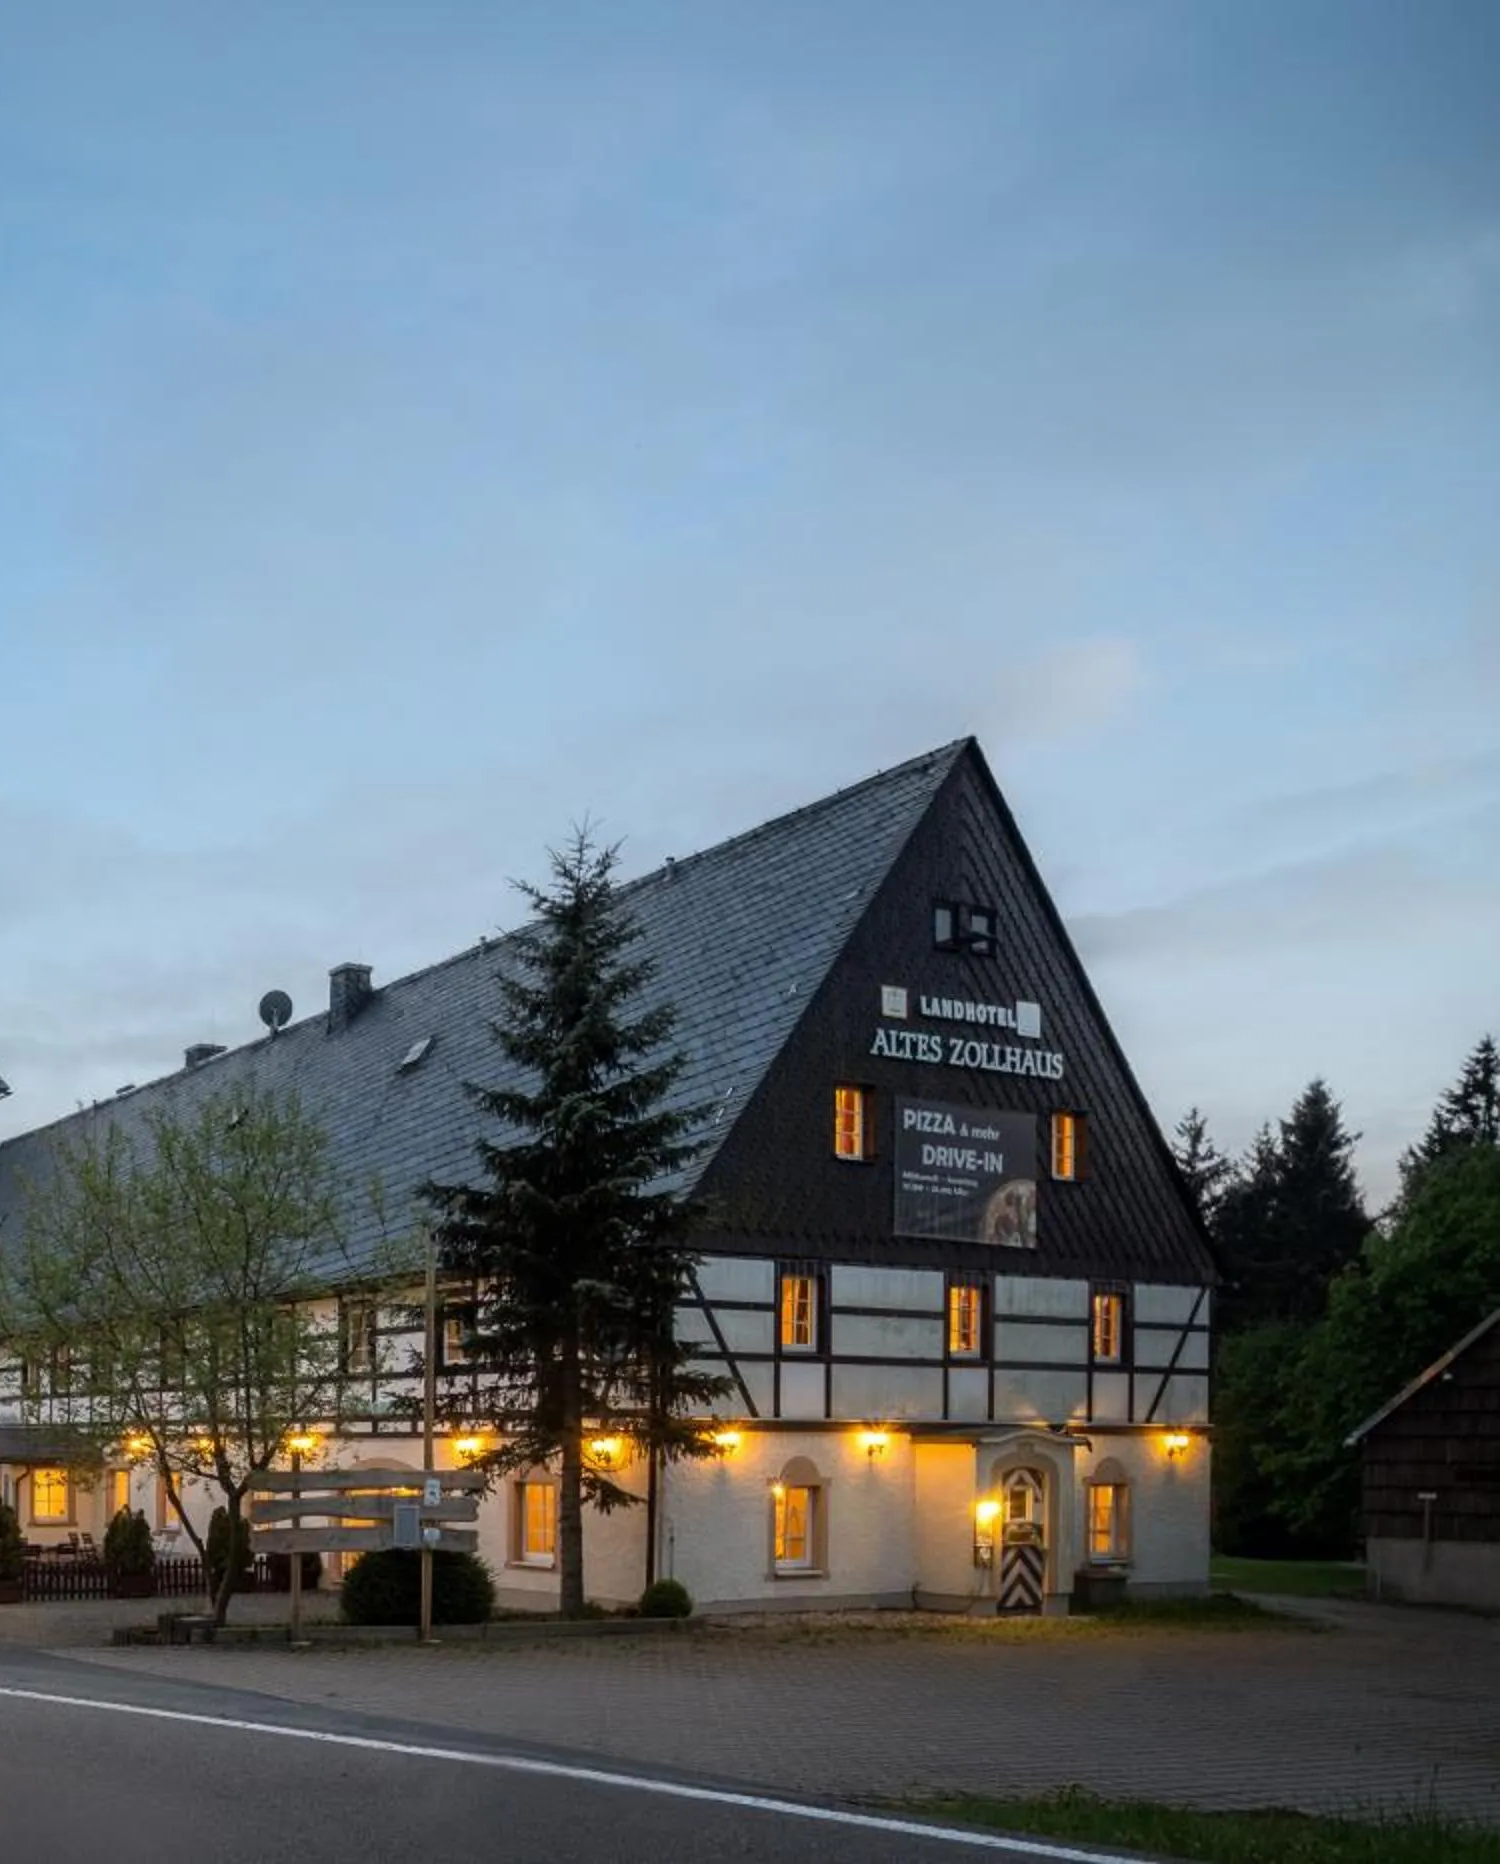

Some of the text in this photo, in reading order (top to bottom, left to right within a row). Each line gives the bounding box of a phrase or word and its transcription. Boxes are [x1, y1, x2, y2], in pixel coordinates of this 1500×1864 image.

[920, 995, 1017, 1026] LANDHOTEL
[870, 1027, 1064, 1080] ALTES ZOLLHAUS
[903, 1108, 956, 1135] PIZZA
[922, 1144, 1004, 1174] DRIVE-IN
